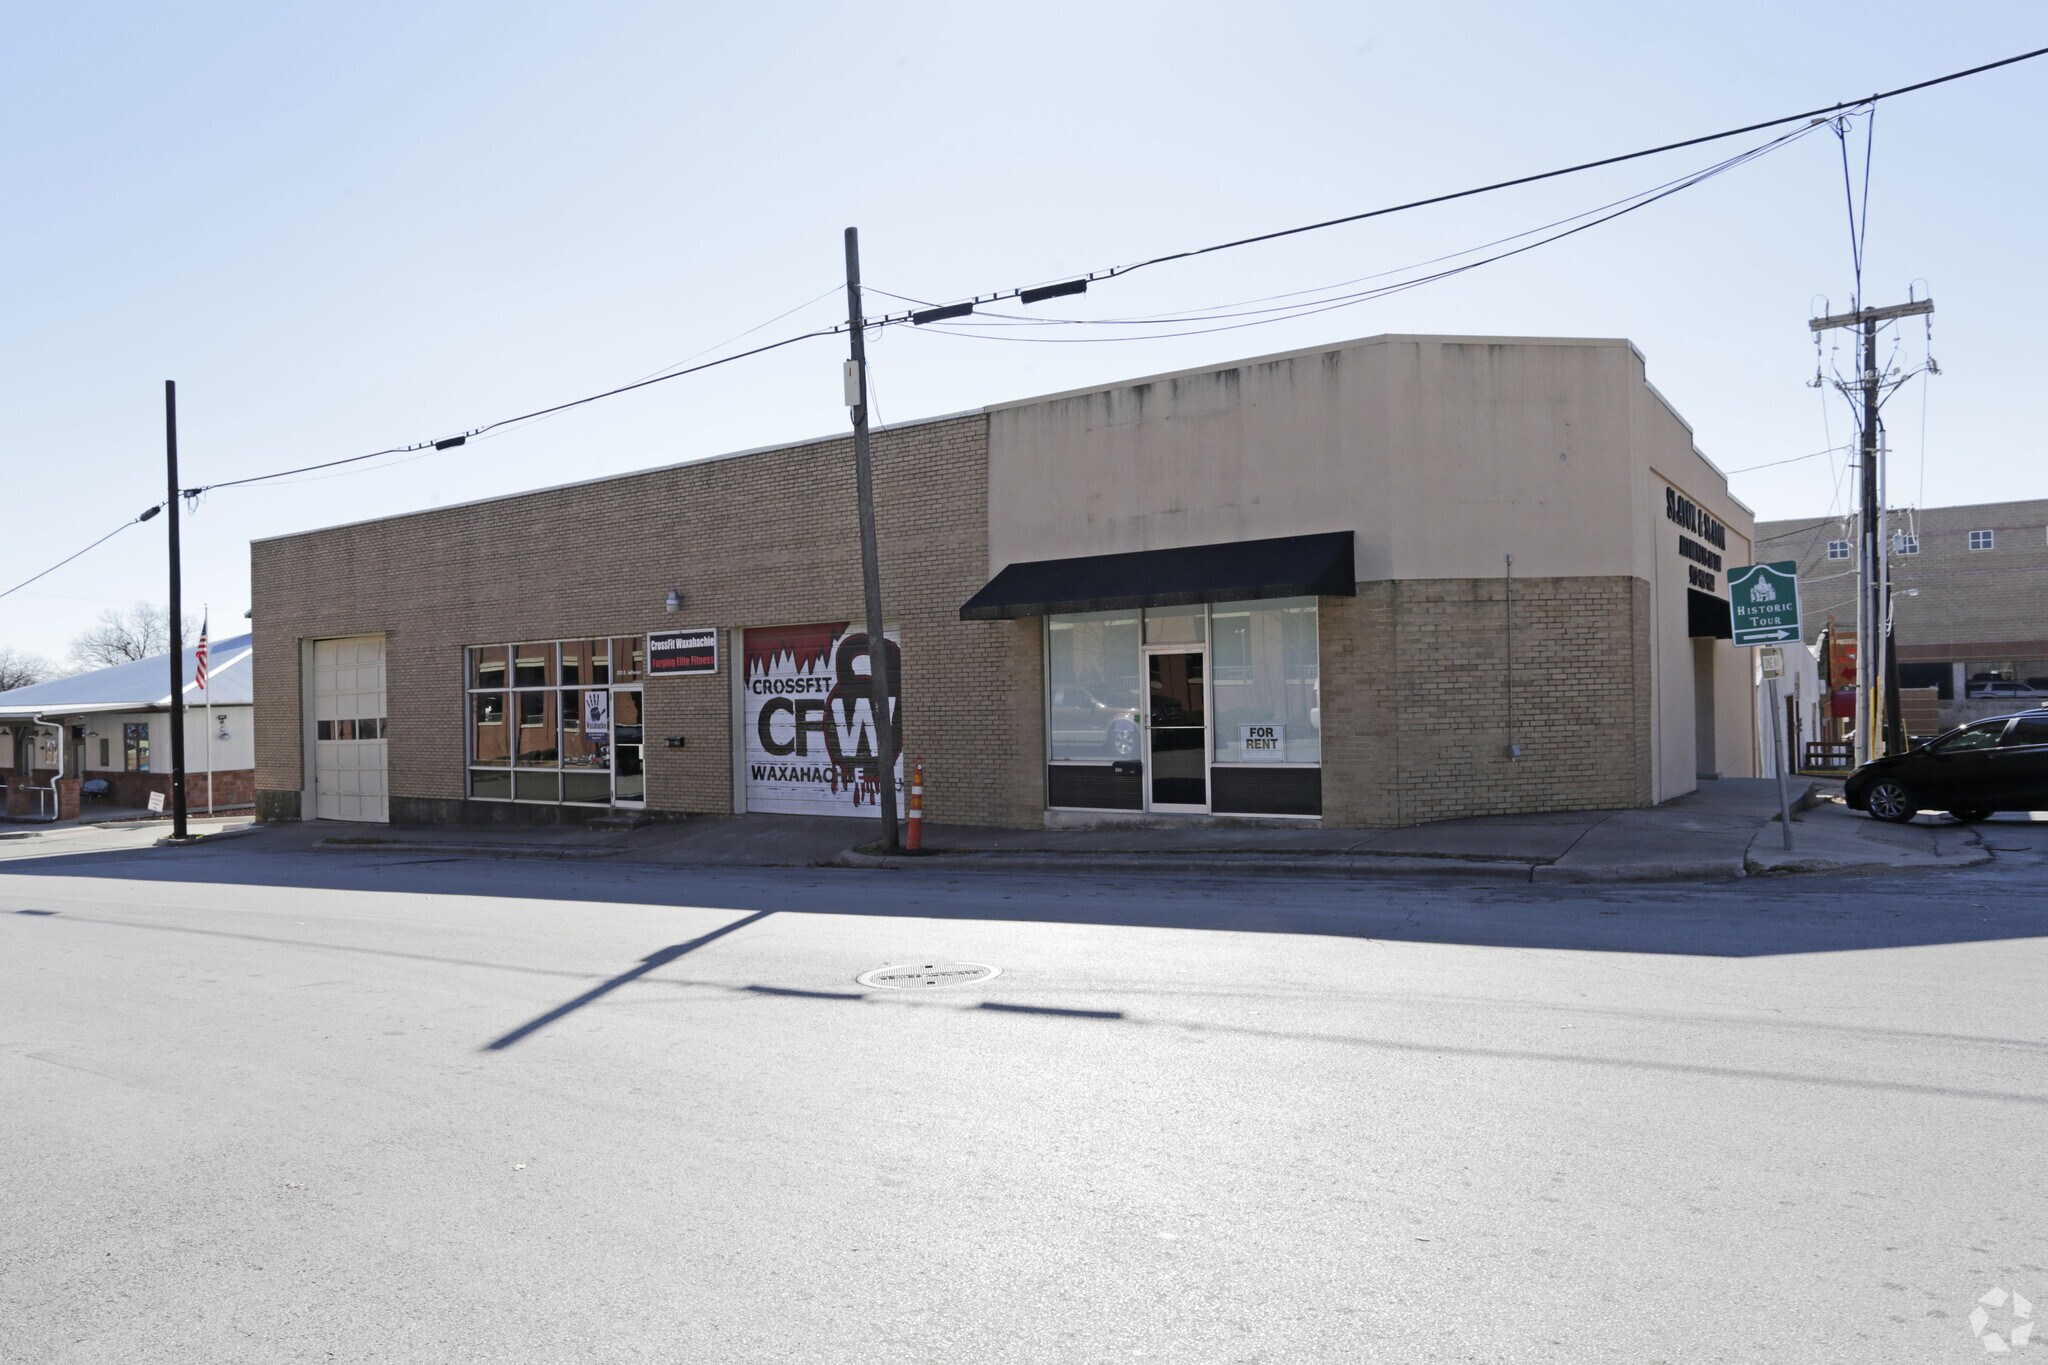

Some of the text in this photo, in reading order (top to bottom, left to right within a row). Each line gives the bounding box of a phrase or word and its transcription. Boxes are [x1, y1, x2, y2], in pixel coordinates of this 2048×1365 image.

[1737, 602, 1793, 616] HISTORIC
[1749, 616, 1782, 627] TOUR
[650, 635, 715, 651] CrossFit Waxahachie
[652, 655, 714, 668] Forging Elite Fitness
[752, 677, 832, 695] CROSSFIT
[757, 696, 897, 757] CFW
[1249, 727, 1274, 738] FOR
[1246, 738, 1278, 750] RENT
